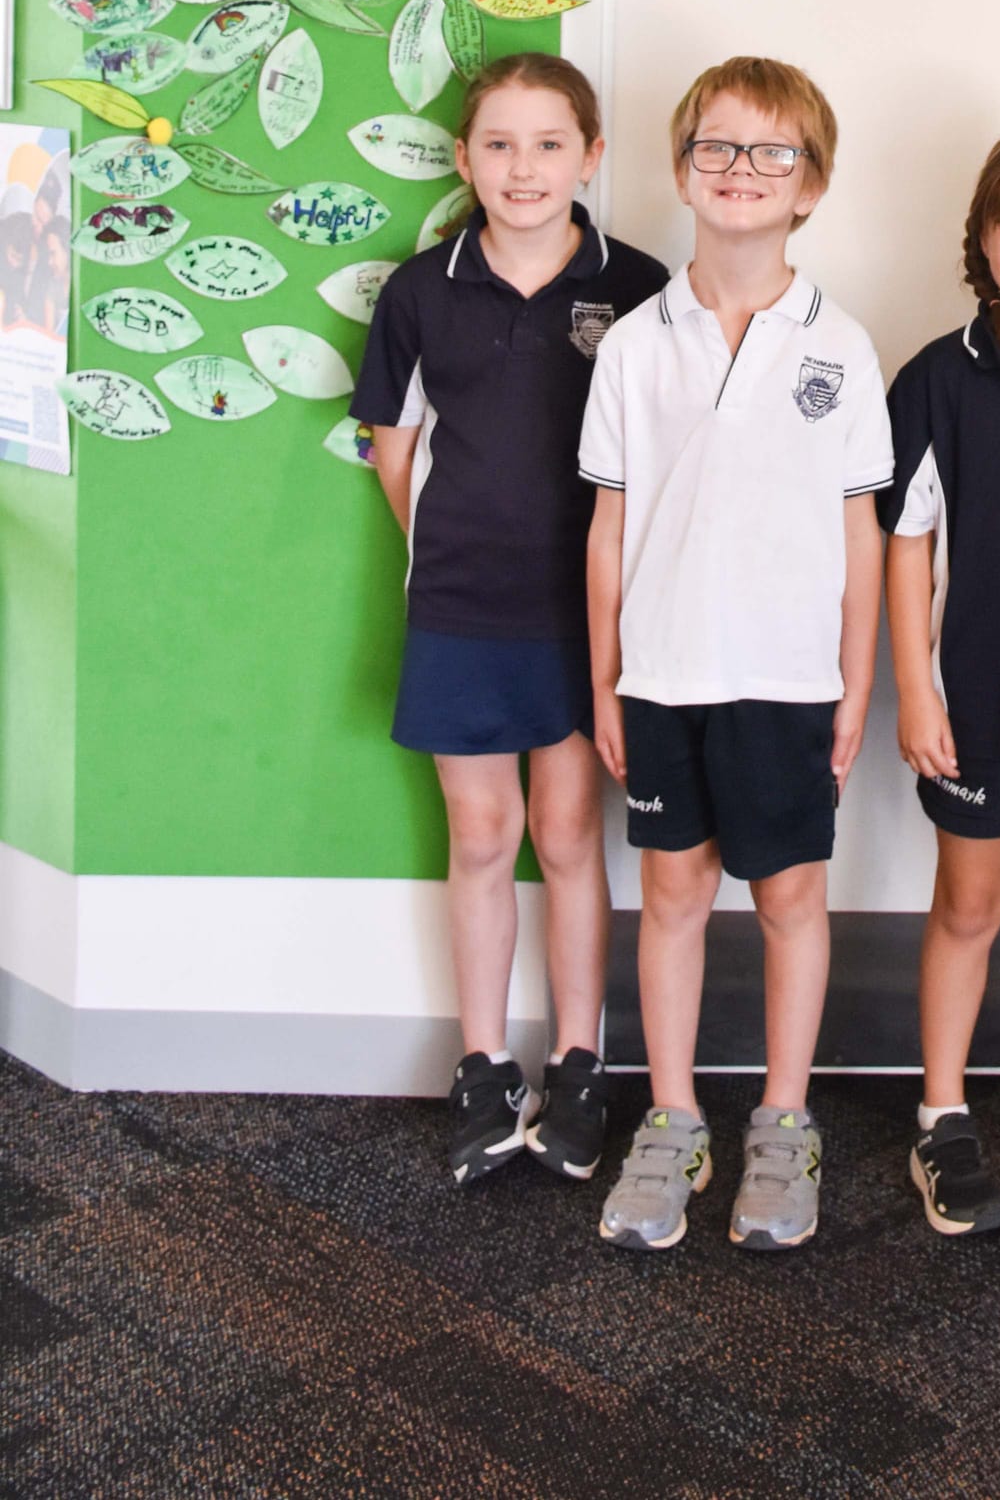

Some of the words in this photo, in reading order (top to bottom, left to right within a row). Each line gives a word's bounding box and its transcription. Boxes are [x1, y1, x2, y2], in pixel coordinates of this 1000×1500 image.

[293, 197, 373, 240] Helpful
[803, 355, 845, 371] RENMARK
[931, 774, 986, 806] enmark
